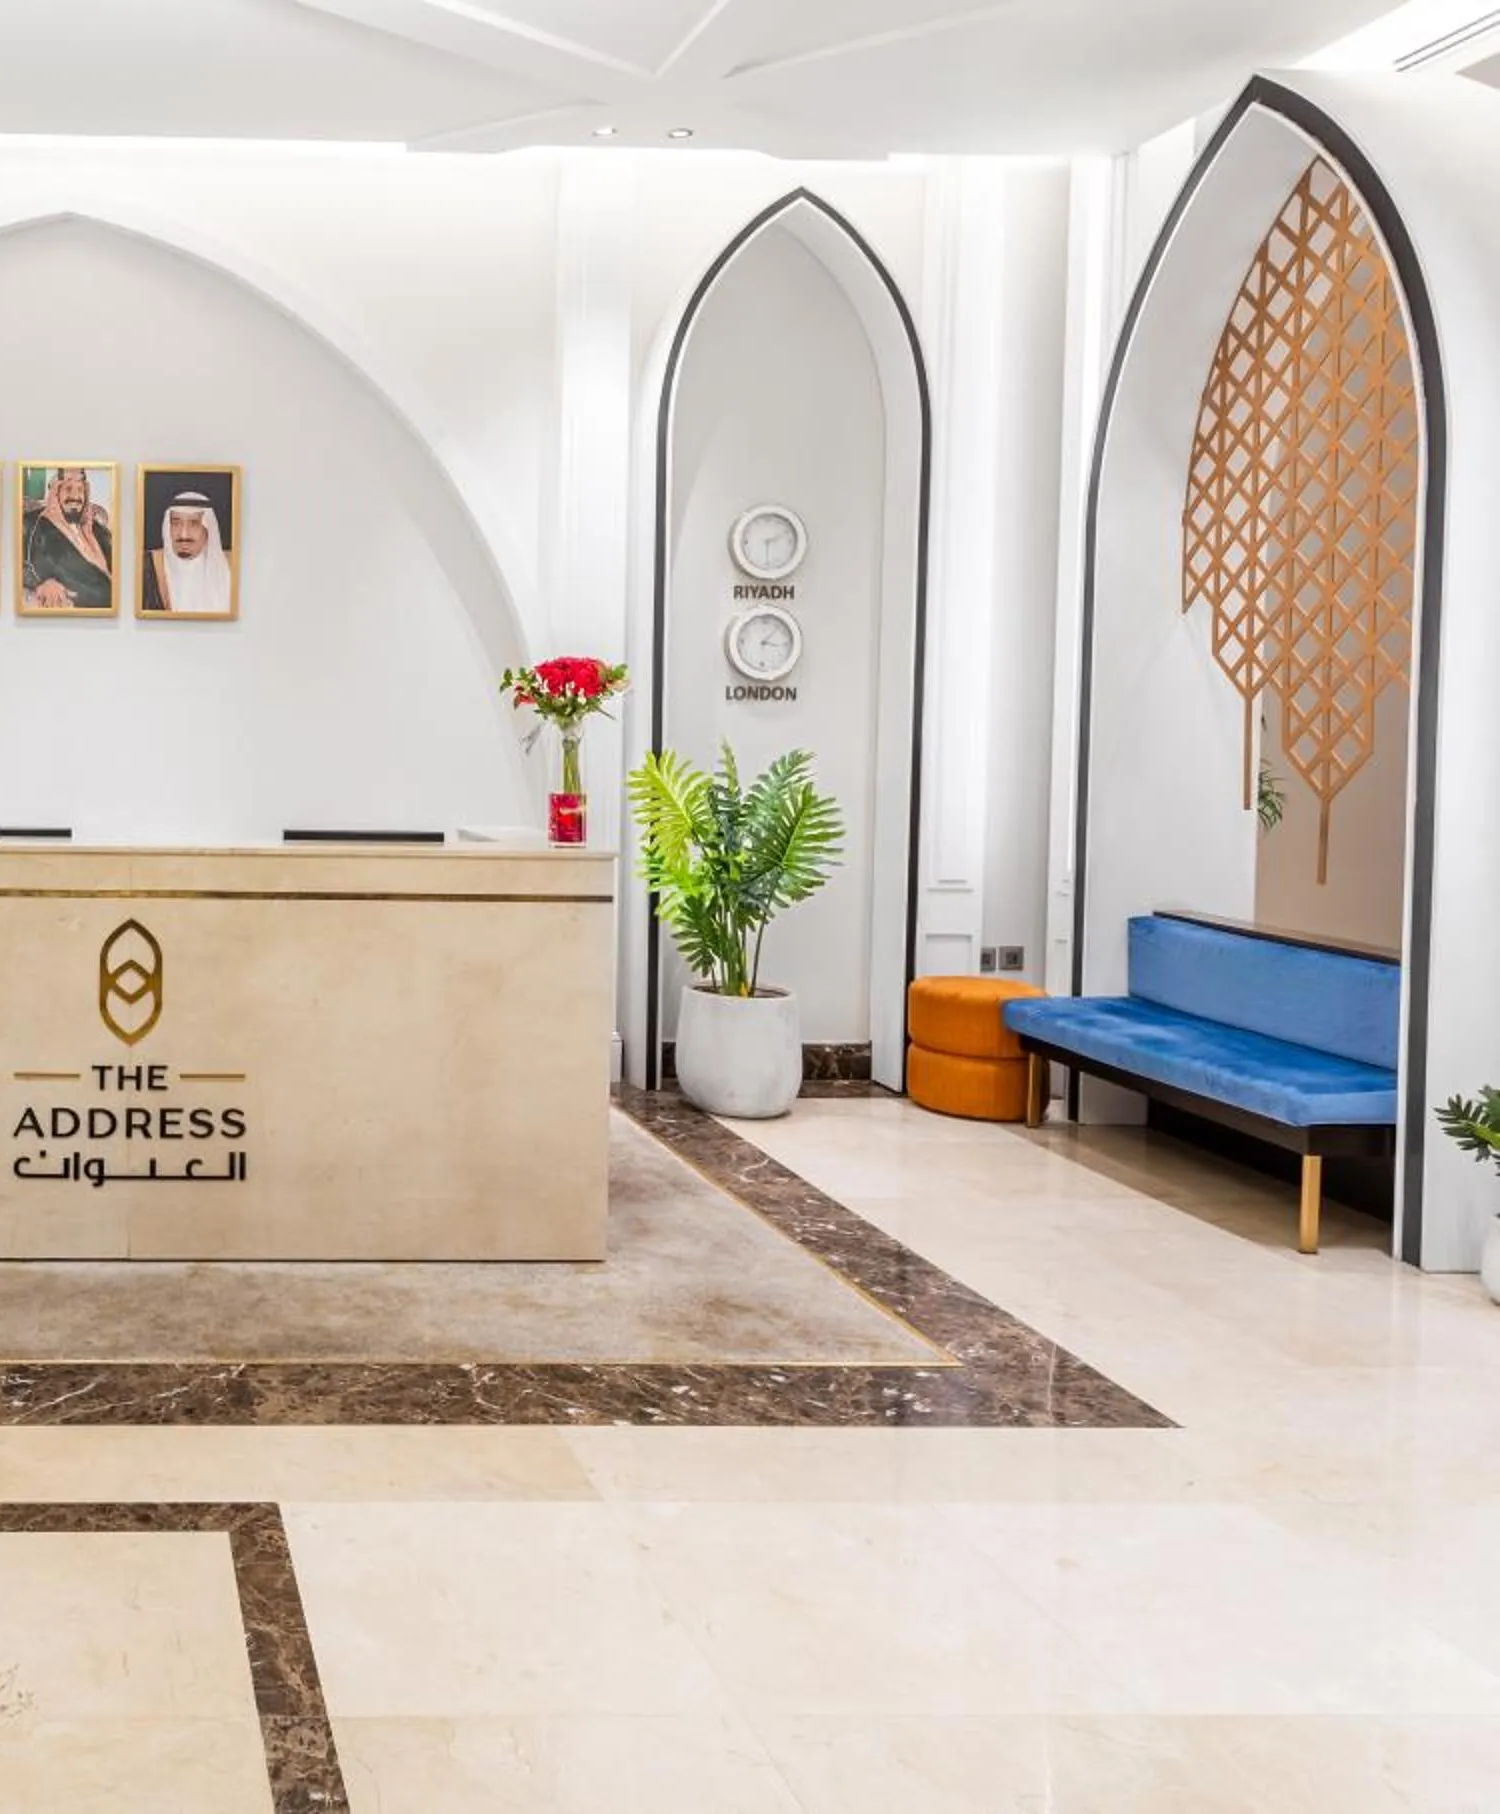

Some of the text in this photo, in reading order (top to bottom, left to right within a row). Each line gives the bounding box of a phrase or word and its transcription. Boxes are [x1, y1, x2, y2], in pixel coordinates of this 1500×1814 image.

[733, 585, 795, 600] RIYADH
[725, 685, 797, 701] LONDON
[91, 1064, 169, 1091] THE
[13, 1107, 247, 1140] ADDRESS
